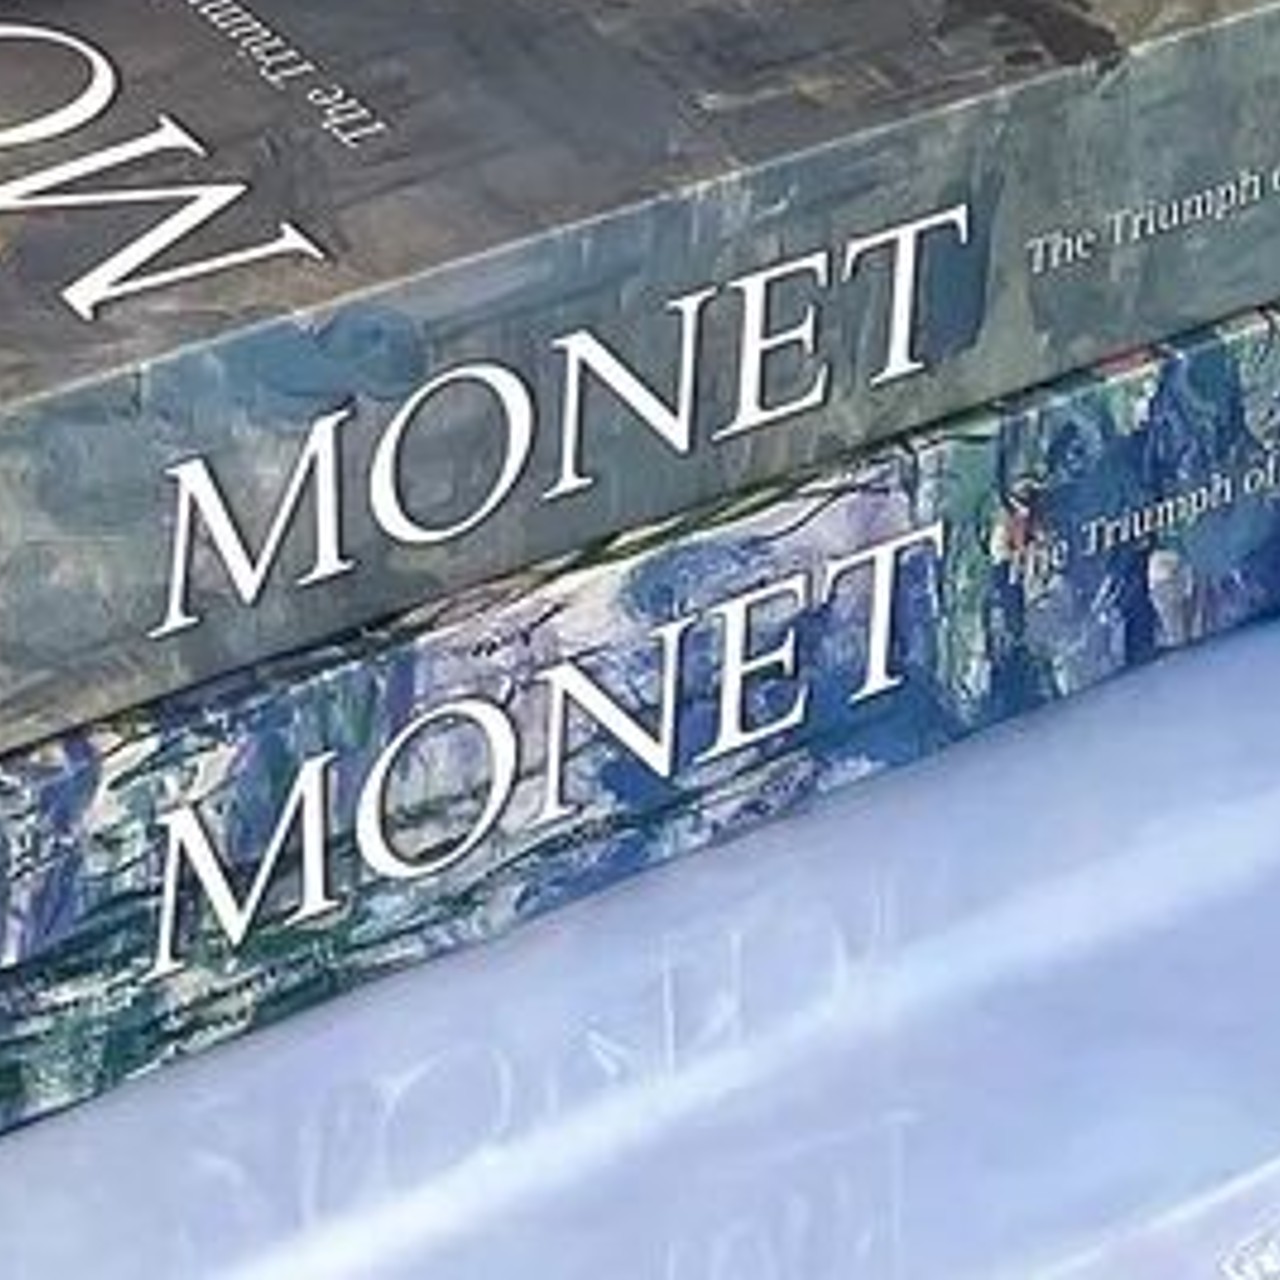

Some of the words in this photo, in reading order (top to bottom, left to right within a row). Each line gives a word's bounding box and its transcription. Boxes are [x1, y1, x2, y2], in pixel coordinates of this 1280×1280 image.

[306, 82, 387, 149] The
[1026, 229, 1094, 275] The
[1104, 165, 1263, 246] Triumph
[150, 206, 969, 639] MONET
[1080, 466, 1233, 547] Triumph
[152, 521, 944, 983] MONET
